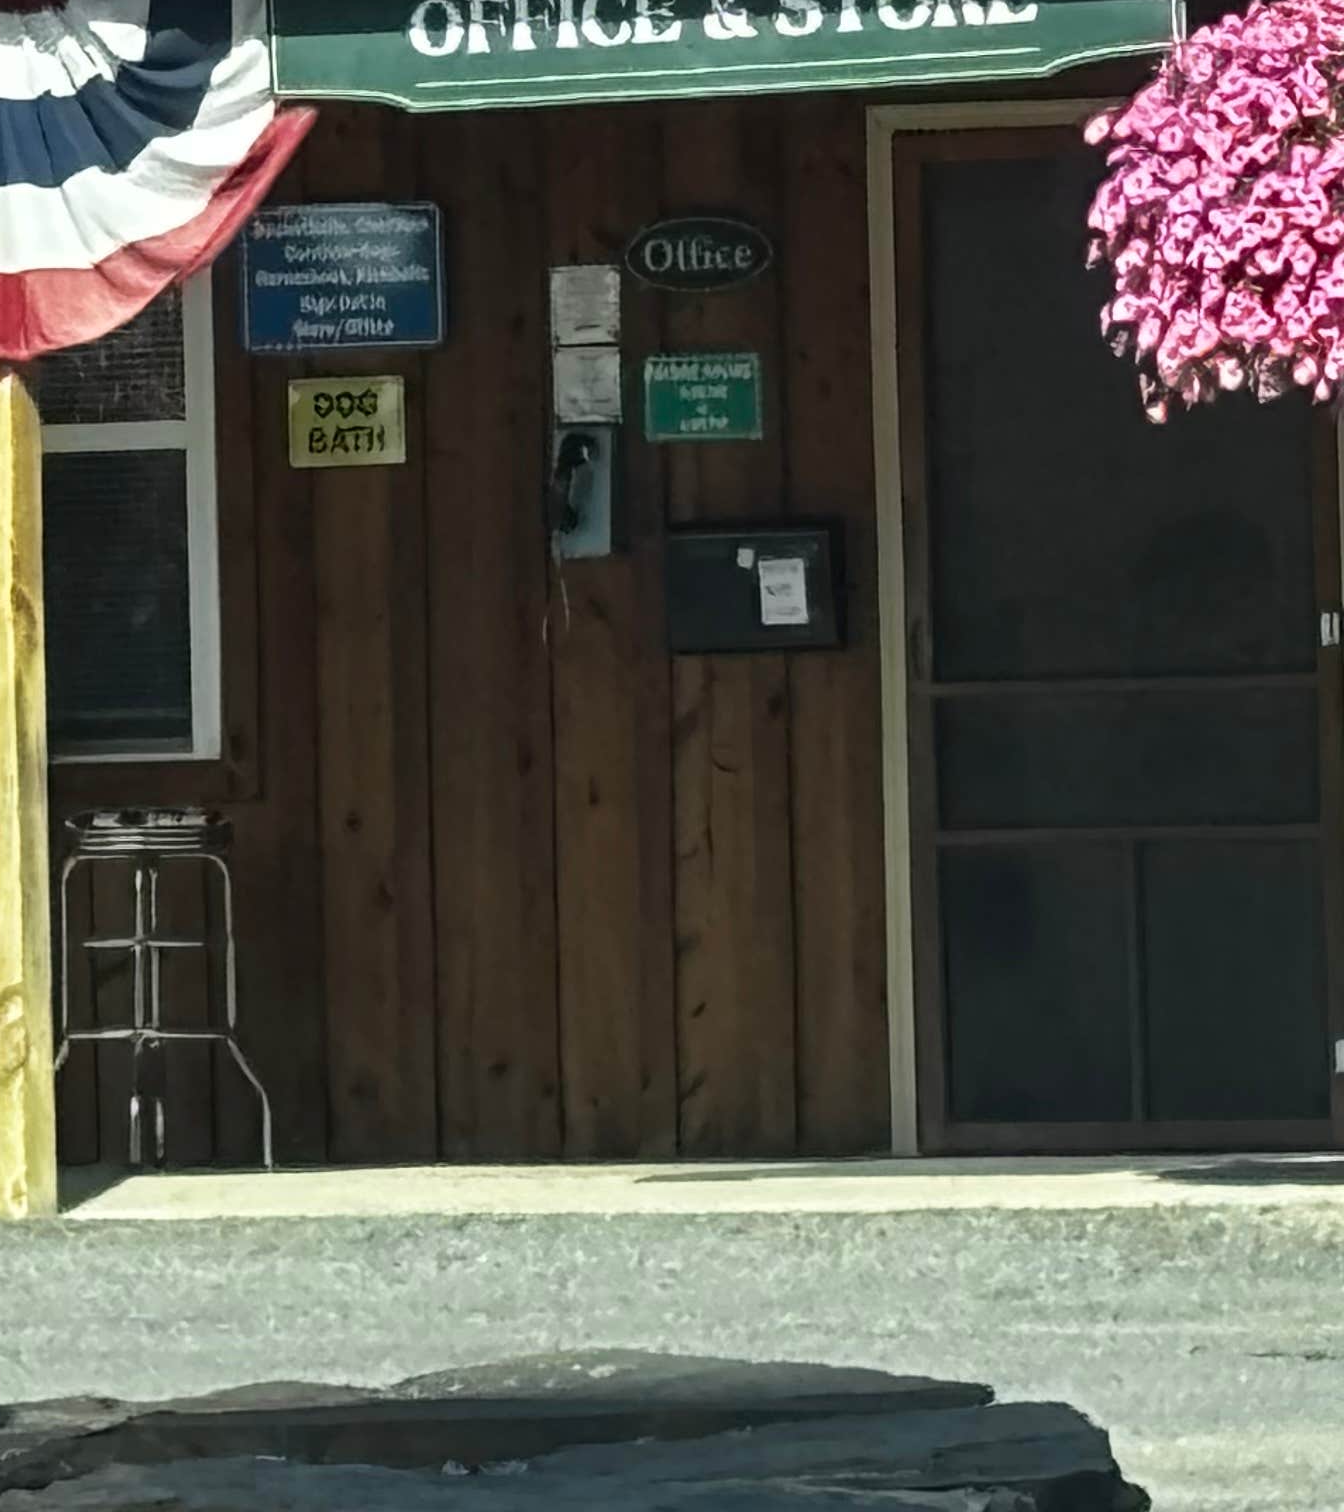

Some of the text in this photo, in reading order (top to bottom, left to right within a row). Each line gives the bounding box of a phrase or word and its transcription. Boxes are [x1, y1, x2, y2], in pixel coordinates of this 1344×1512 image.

[643, 235, 753, 273] Office
[313, 389, 378, 419] DOG
[308, 424, 385, 455] BATH
